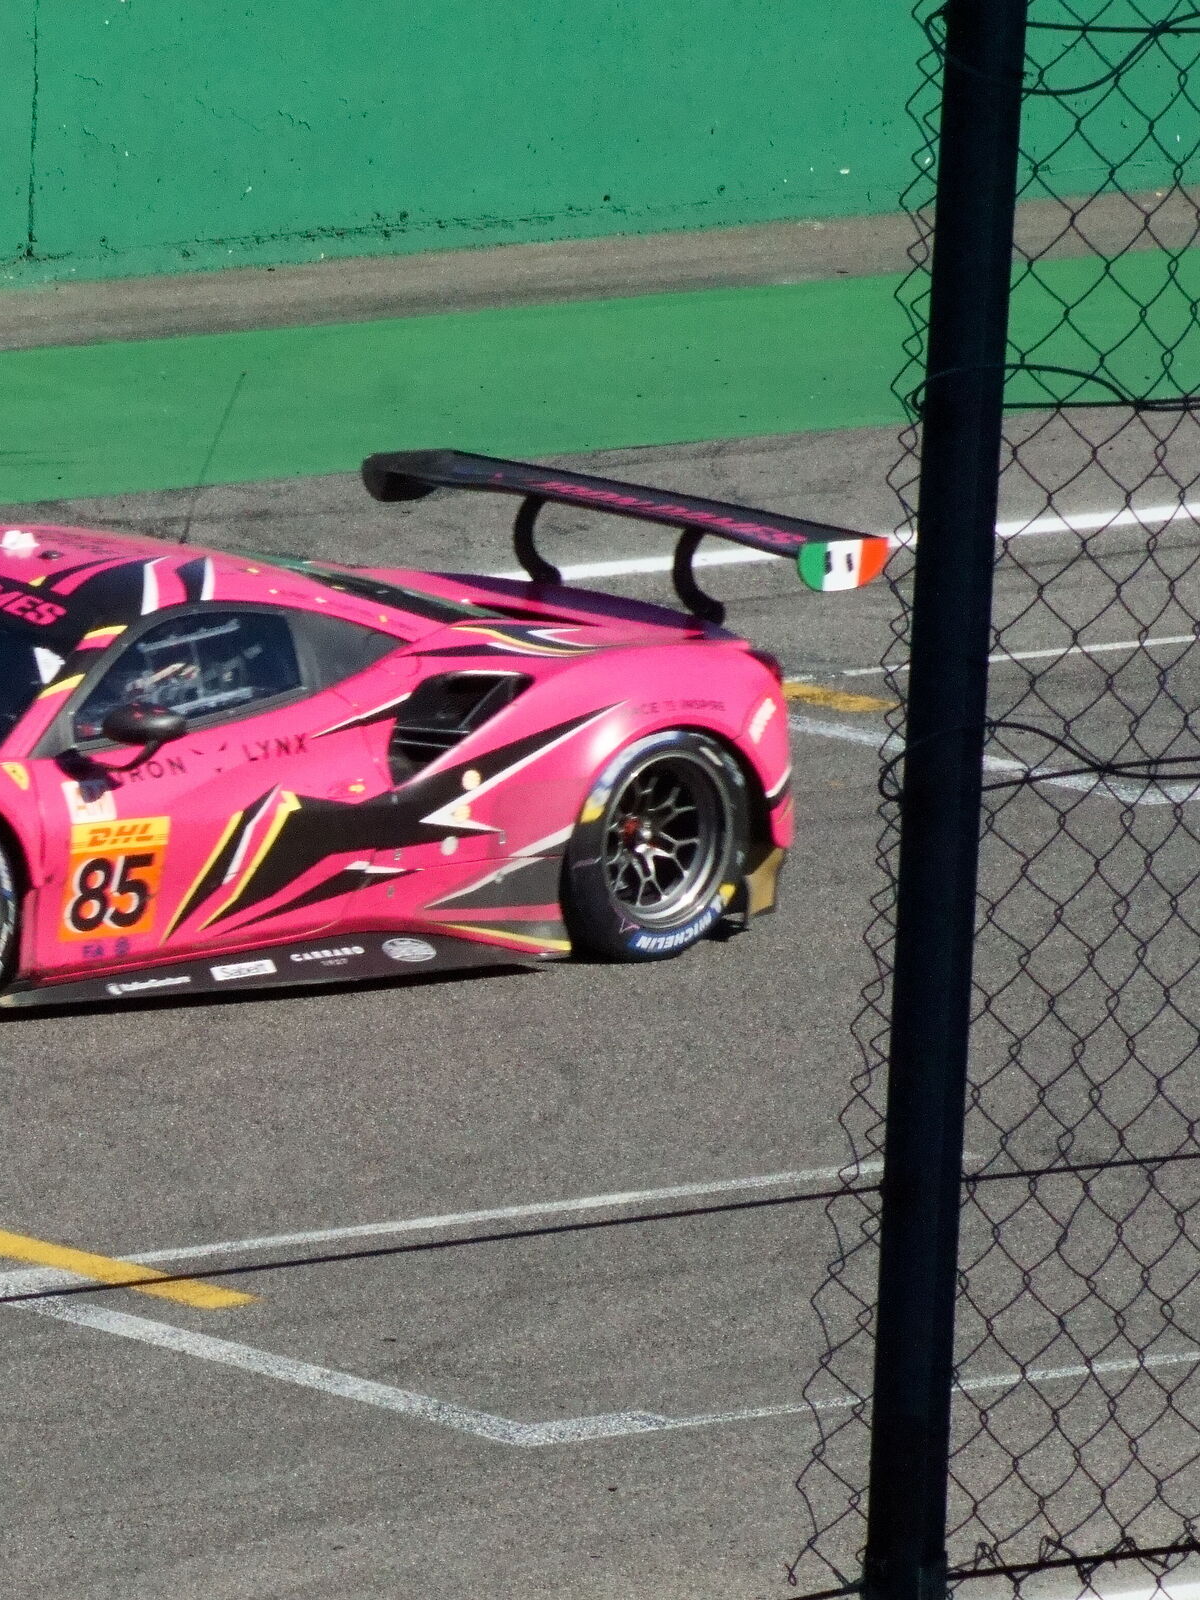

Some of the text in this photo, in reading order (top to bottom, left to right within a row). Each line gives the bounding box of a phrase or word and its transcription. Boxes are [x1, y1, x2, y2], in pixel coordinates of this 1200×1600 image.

[242, 734, 308, 762] LYNX
[87, 823, 155, 848] DHL
[64, 852, 156, 933] 85
[636, 910, 712, 950] MICHELIN
